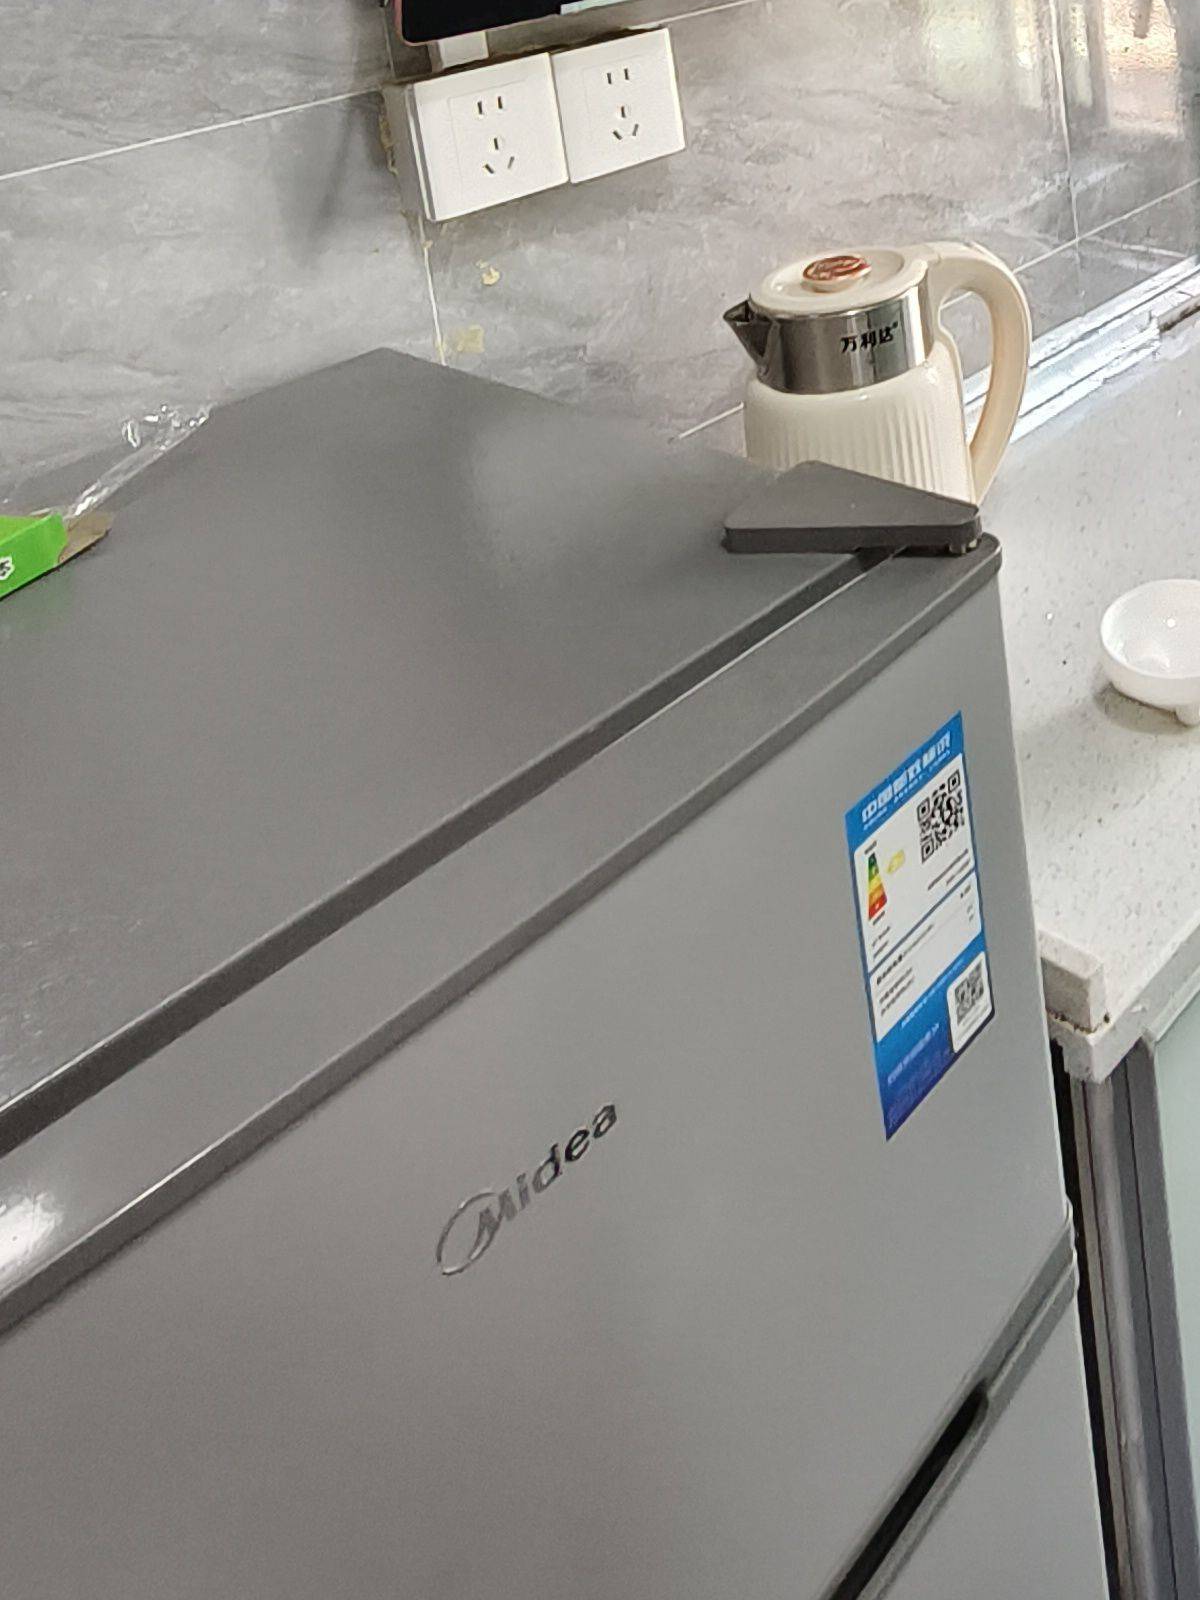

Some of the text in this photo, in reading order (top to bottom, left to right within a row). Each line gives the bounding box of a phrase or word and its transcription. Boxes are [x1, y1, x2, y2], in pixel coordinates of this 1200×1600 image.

[841, 326, 894, 353] 万利达
[436, 1104, 617, 1276] Midea
